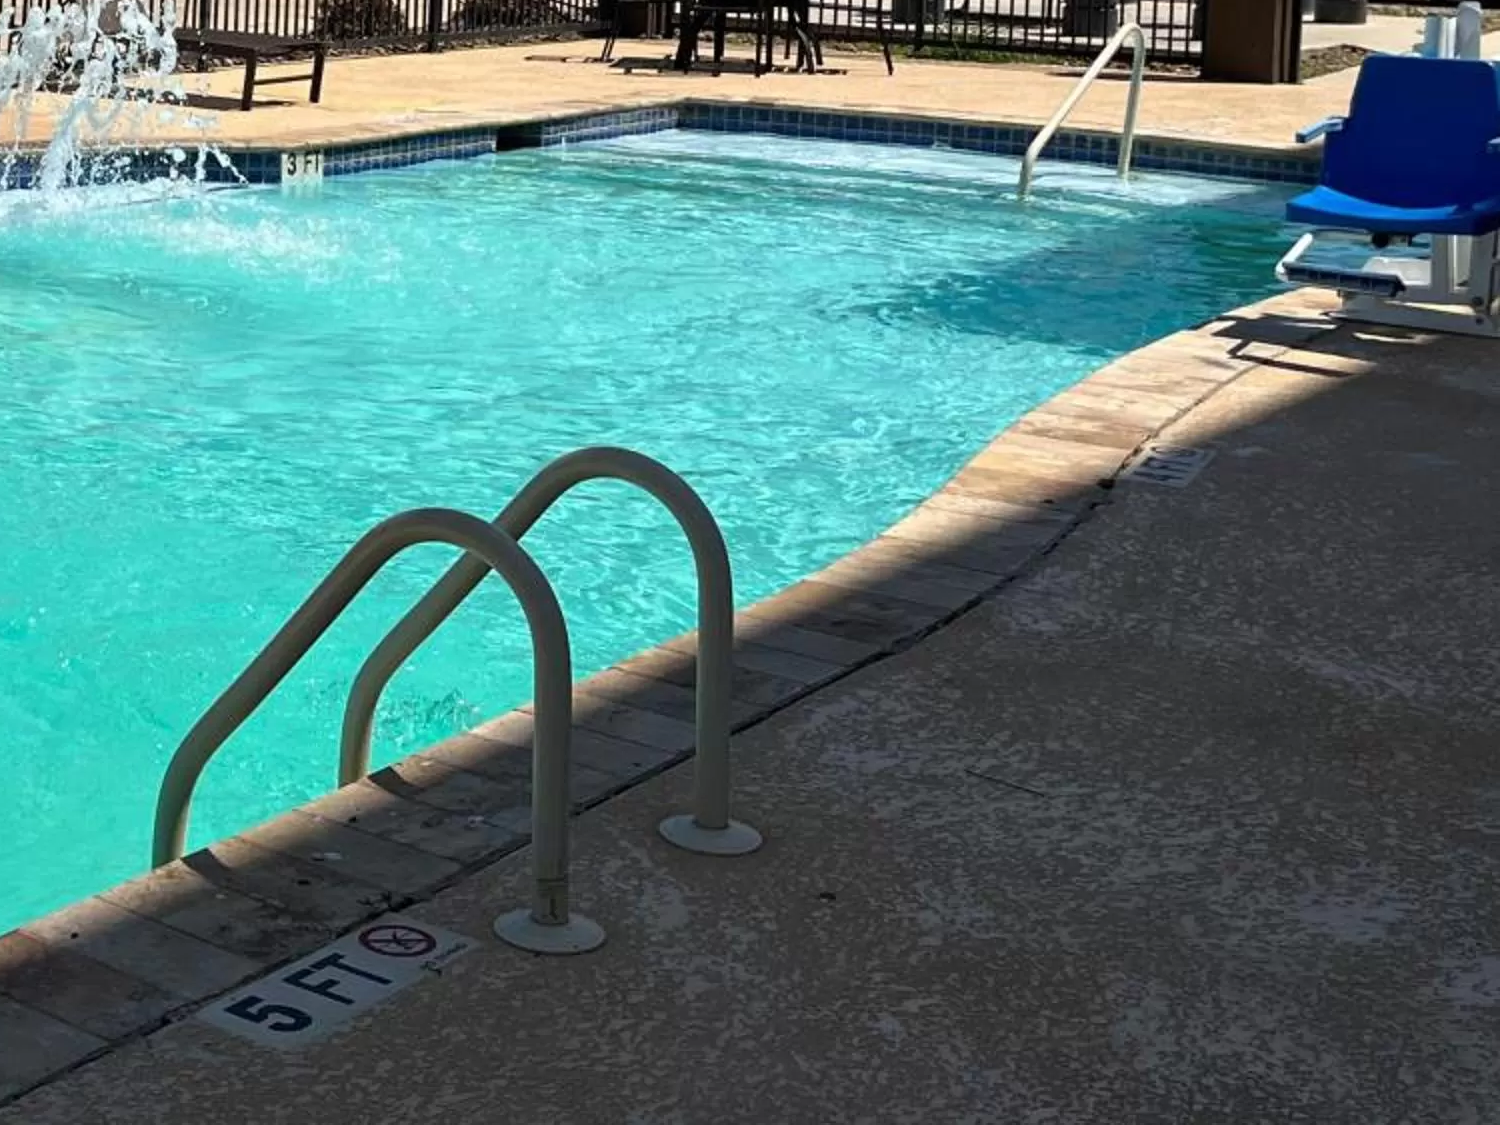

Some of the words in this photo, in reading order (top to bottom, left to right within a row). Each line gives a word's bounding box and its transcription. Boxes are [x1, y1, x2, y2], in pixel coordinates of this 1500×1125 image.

[287, 152, 297, 176] 3
[304, 149, 321, 174] FT
[223, 995, 313, 1032] 5
[282, 952, 394, 1005] FT
